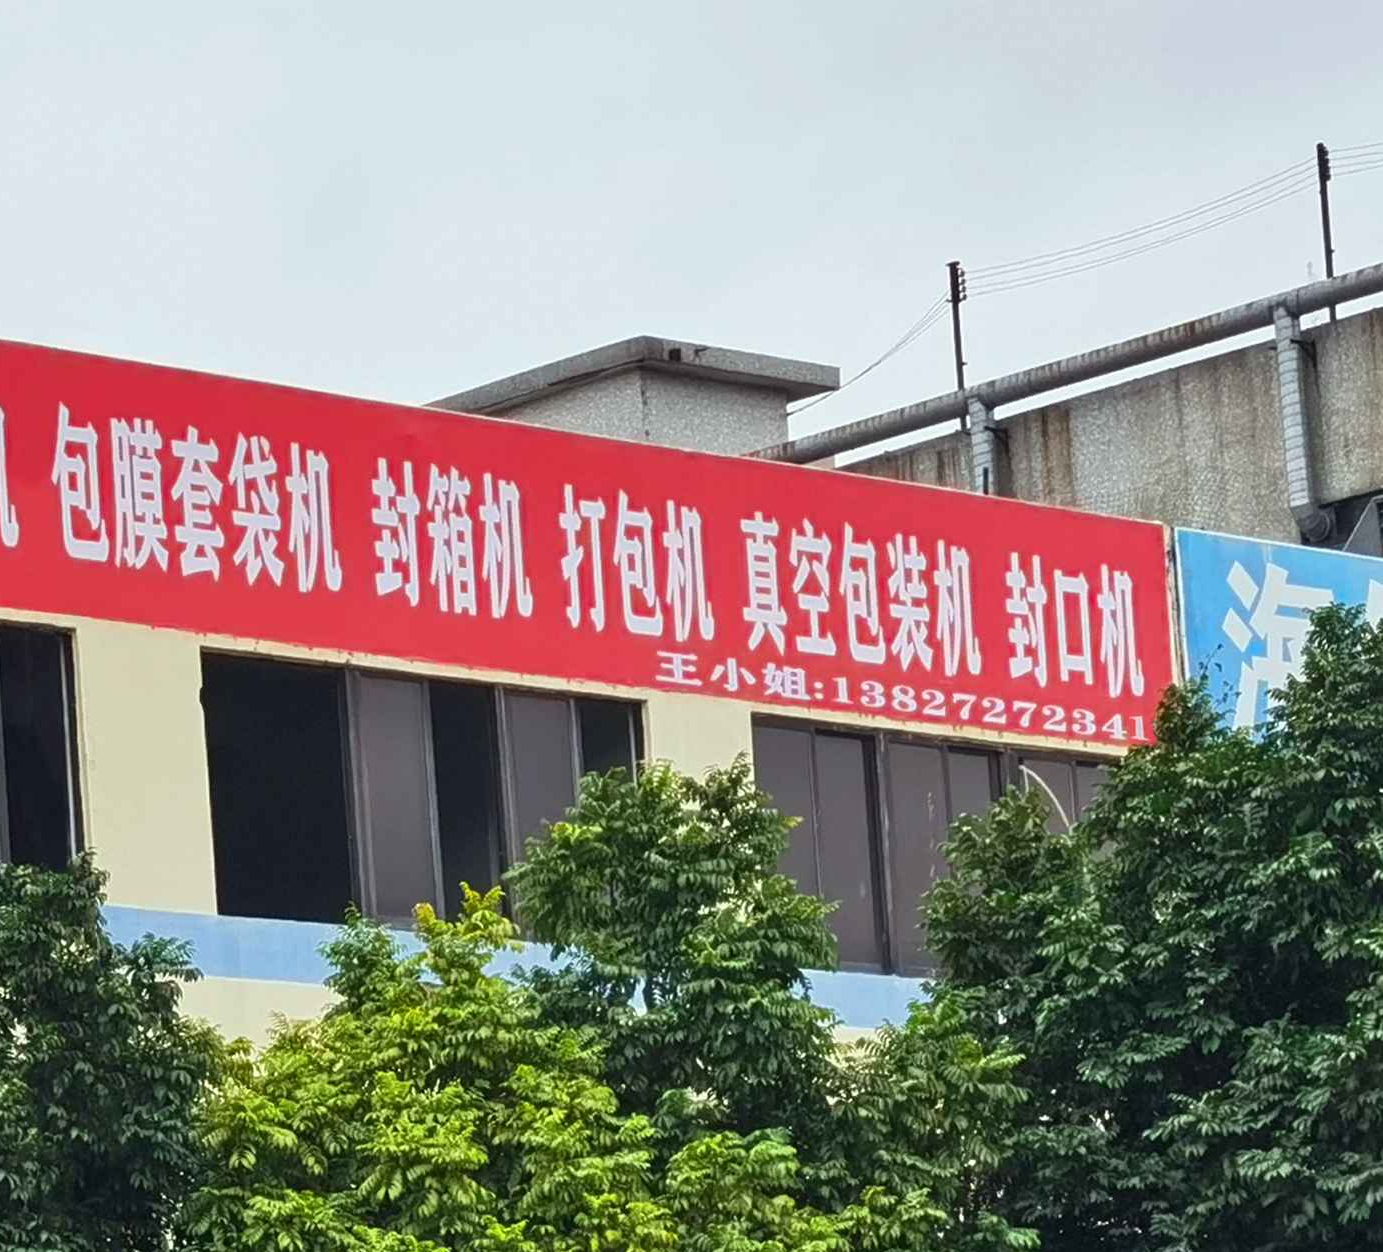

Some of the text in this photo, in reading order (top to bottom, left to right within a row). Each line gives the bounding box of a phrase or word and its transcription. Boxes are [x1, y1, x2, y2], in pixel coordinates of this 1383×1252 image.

[50, 401, 344, 594] 包膜套袋机
[370, 456, 535, 620] 封箱机
[557, 482, 716, 644] 打包机
[738, 510, 983, 679] 真空包装机
[1003, 550, 1146, 700] 封口机
